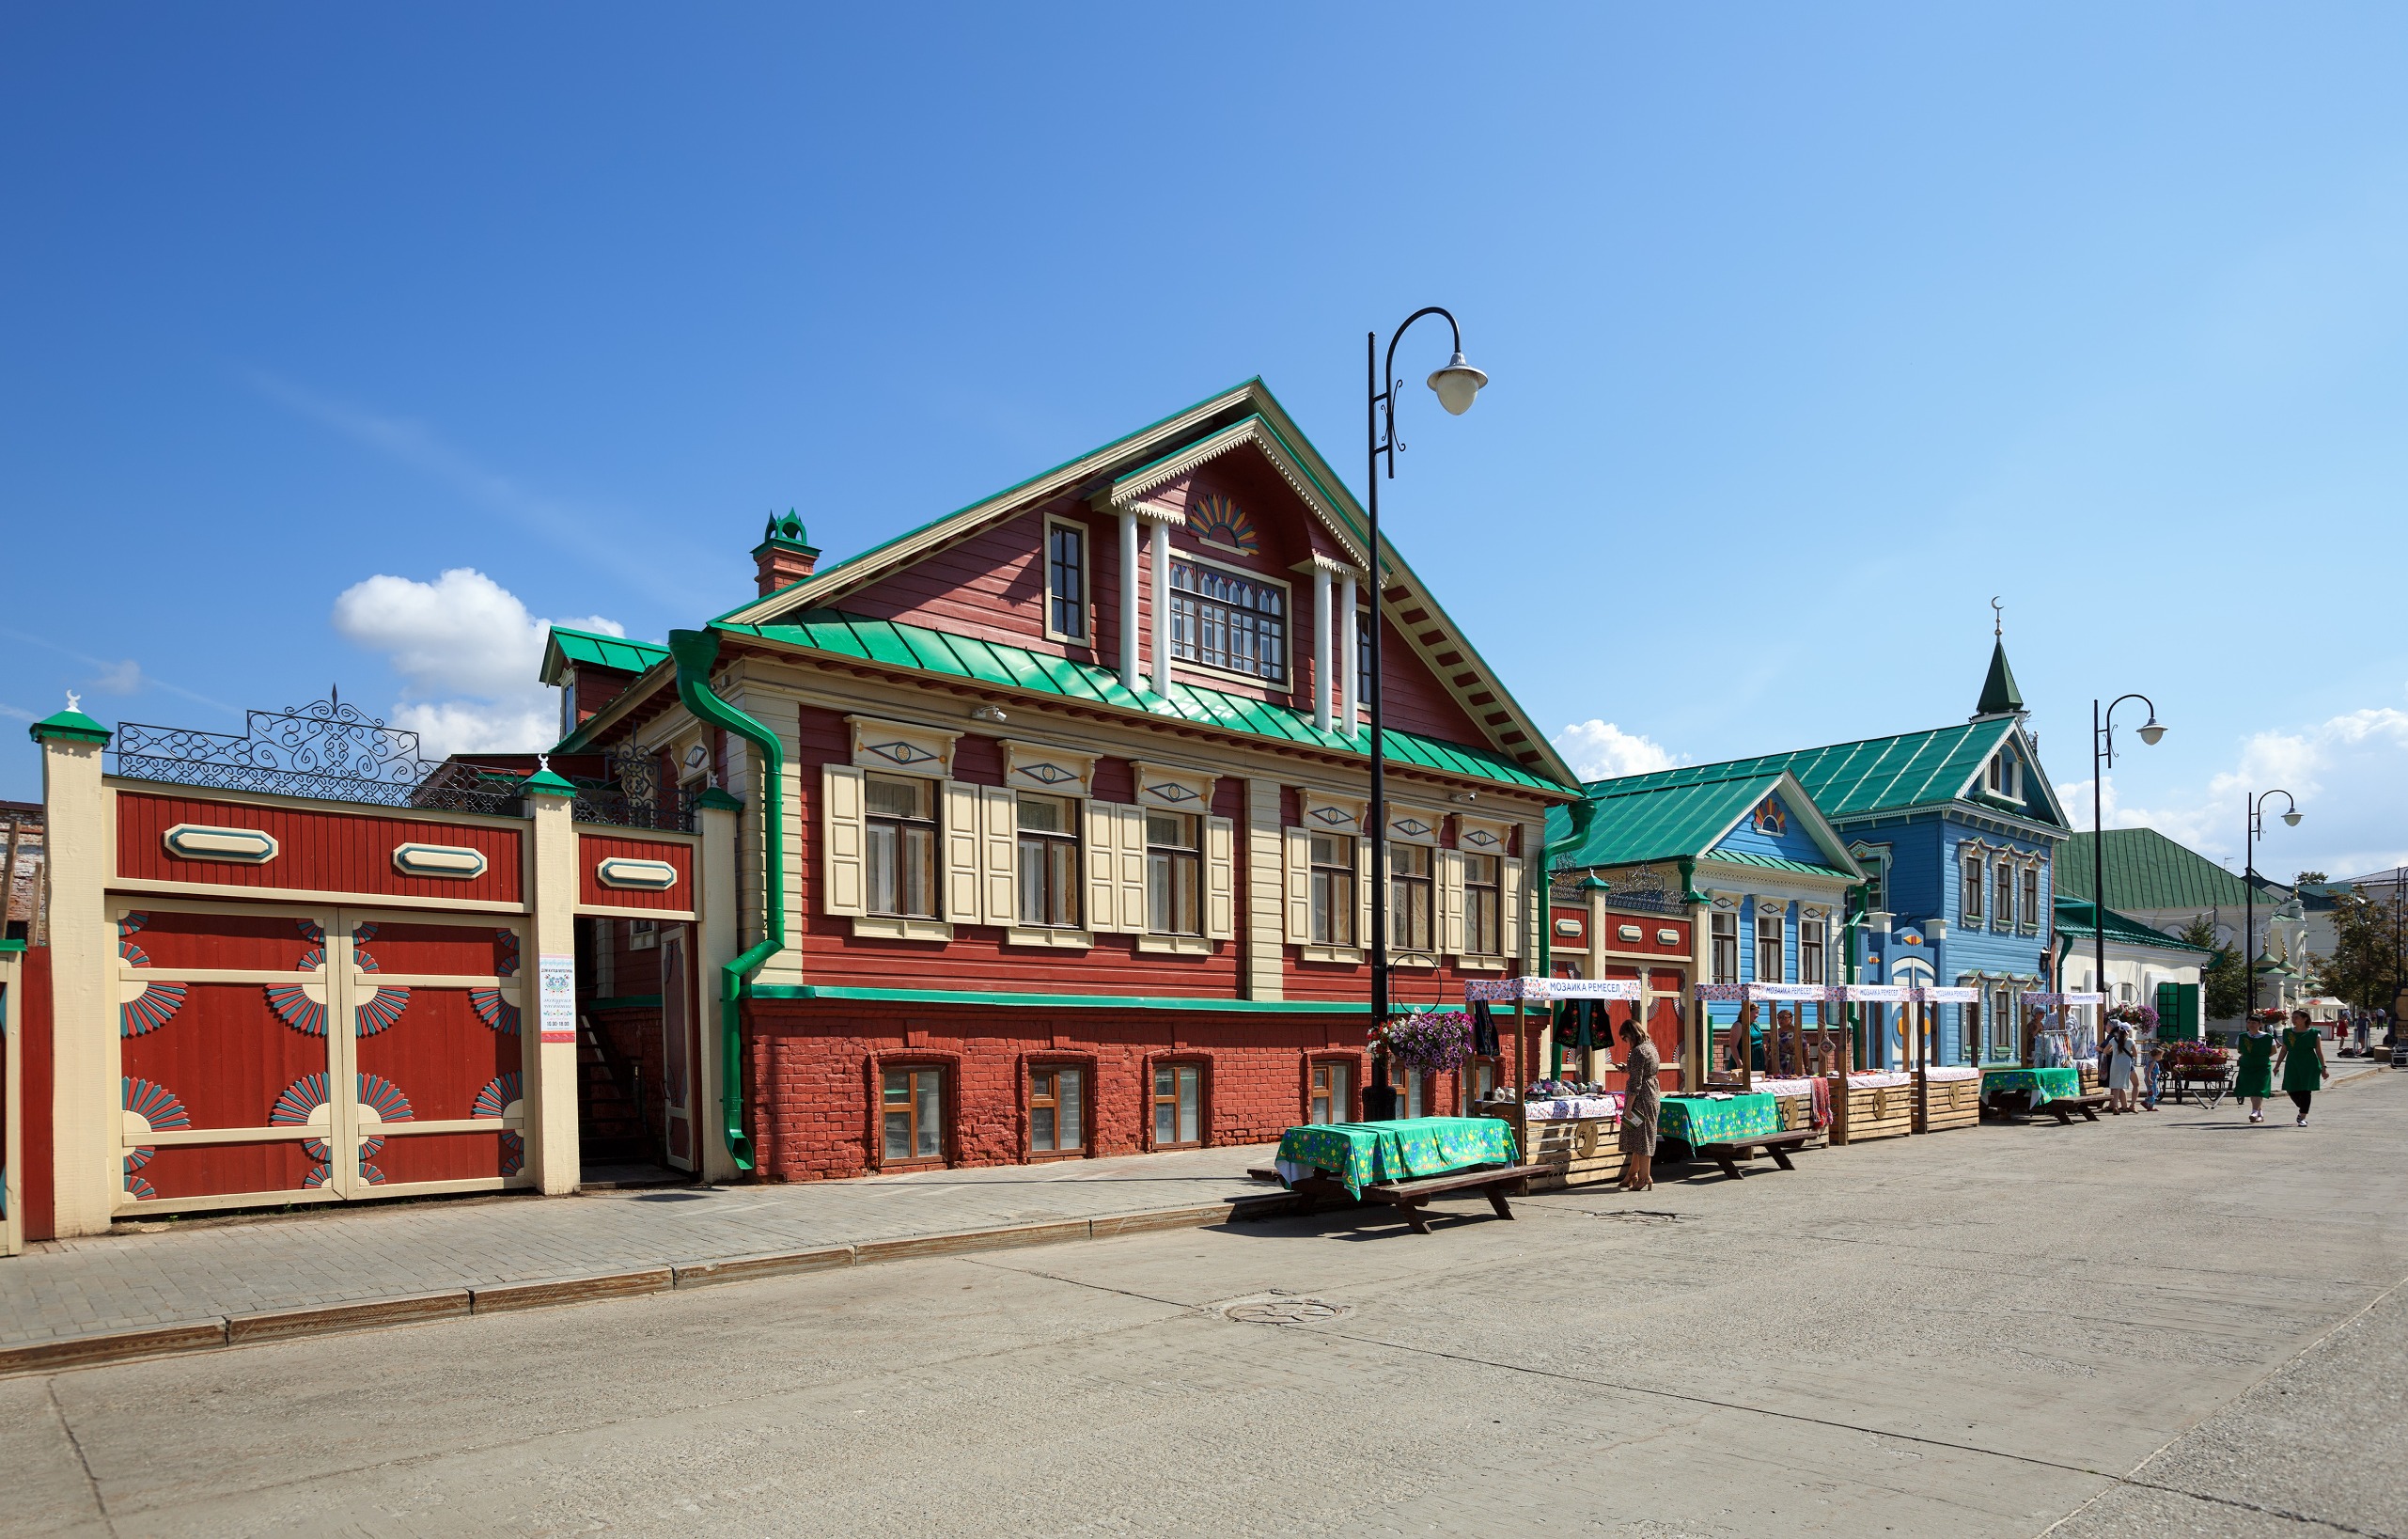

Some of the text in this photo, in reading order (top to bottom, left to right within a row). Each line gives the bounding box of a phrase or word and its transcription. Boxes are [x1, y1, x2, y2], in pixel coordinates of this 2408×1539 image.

[1550, 982, 1620, 993] МОЗАИКА РЕМЕСЕЛ
[1765, 986, 1790, 995] МОЗАИКА
